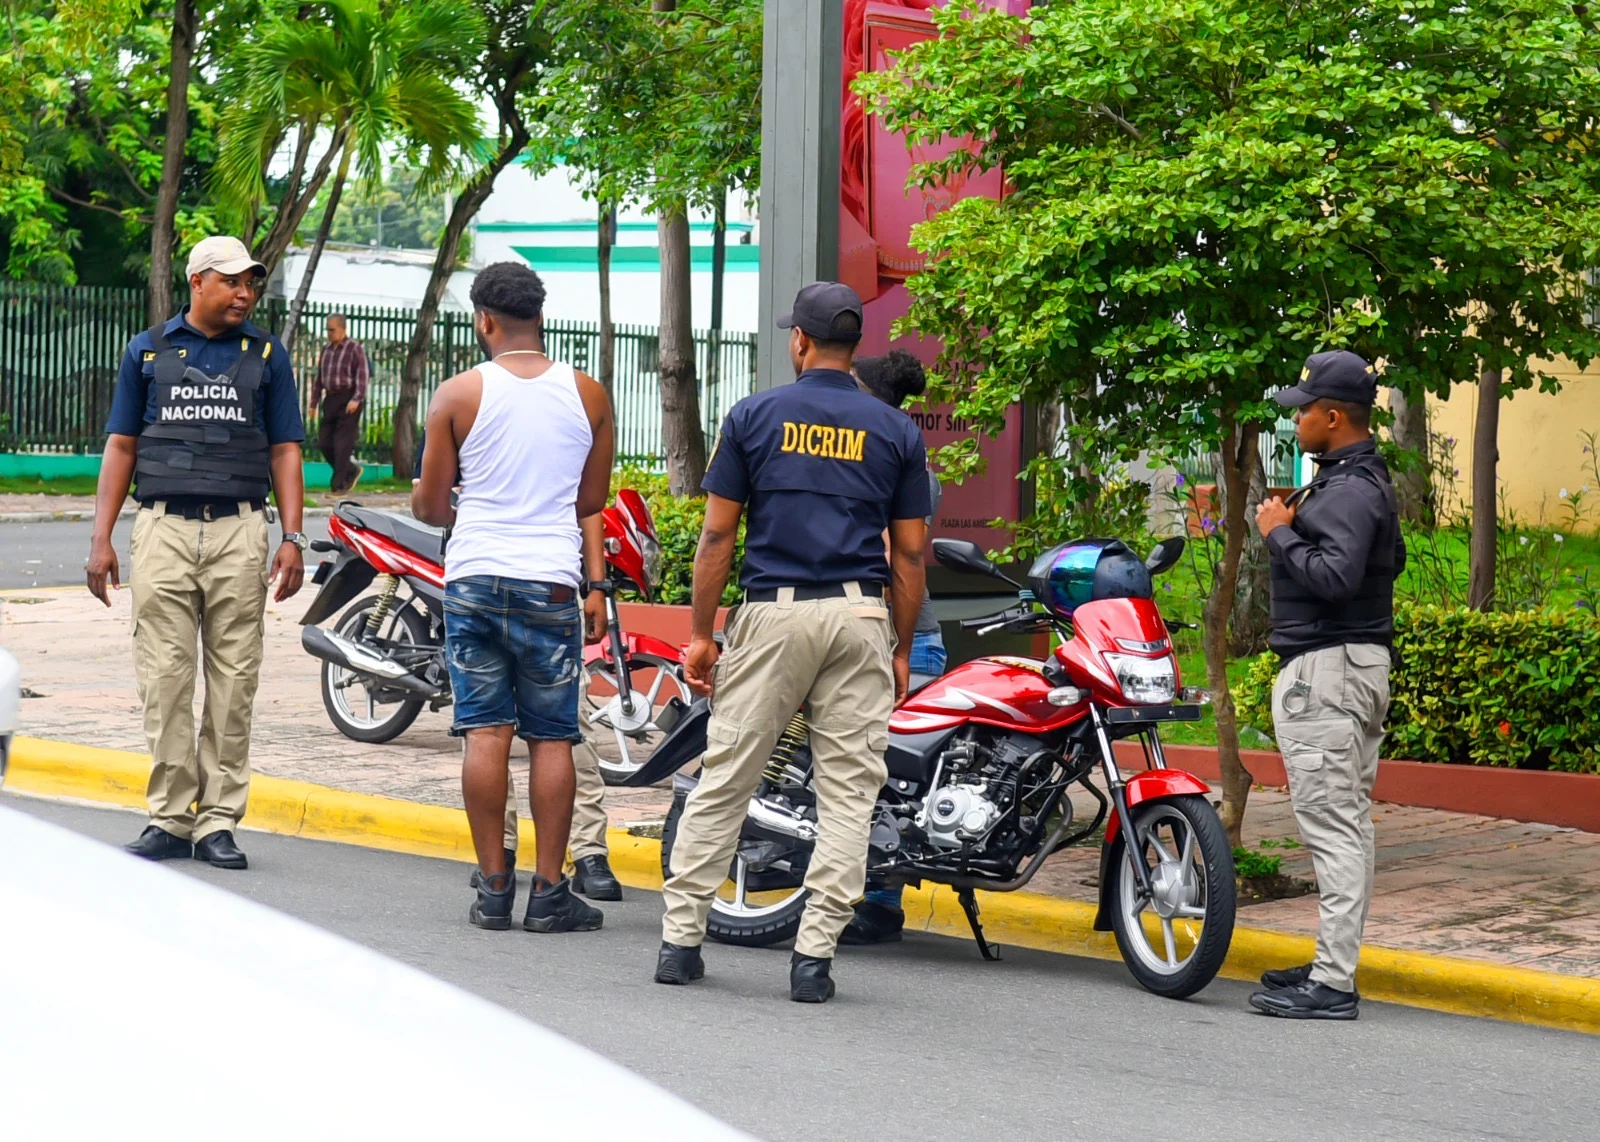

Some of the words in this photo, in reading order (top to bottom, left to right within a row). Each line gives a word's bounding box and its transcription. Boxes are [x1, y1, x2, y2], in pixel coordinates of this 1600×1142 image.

[171, 385, 238, 401] POLICIA
[161, 405, 247, 422] NACIONAL
[906, 411, 942, 431] mor
[781, 421, 867, 462] DICRIM
